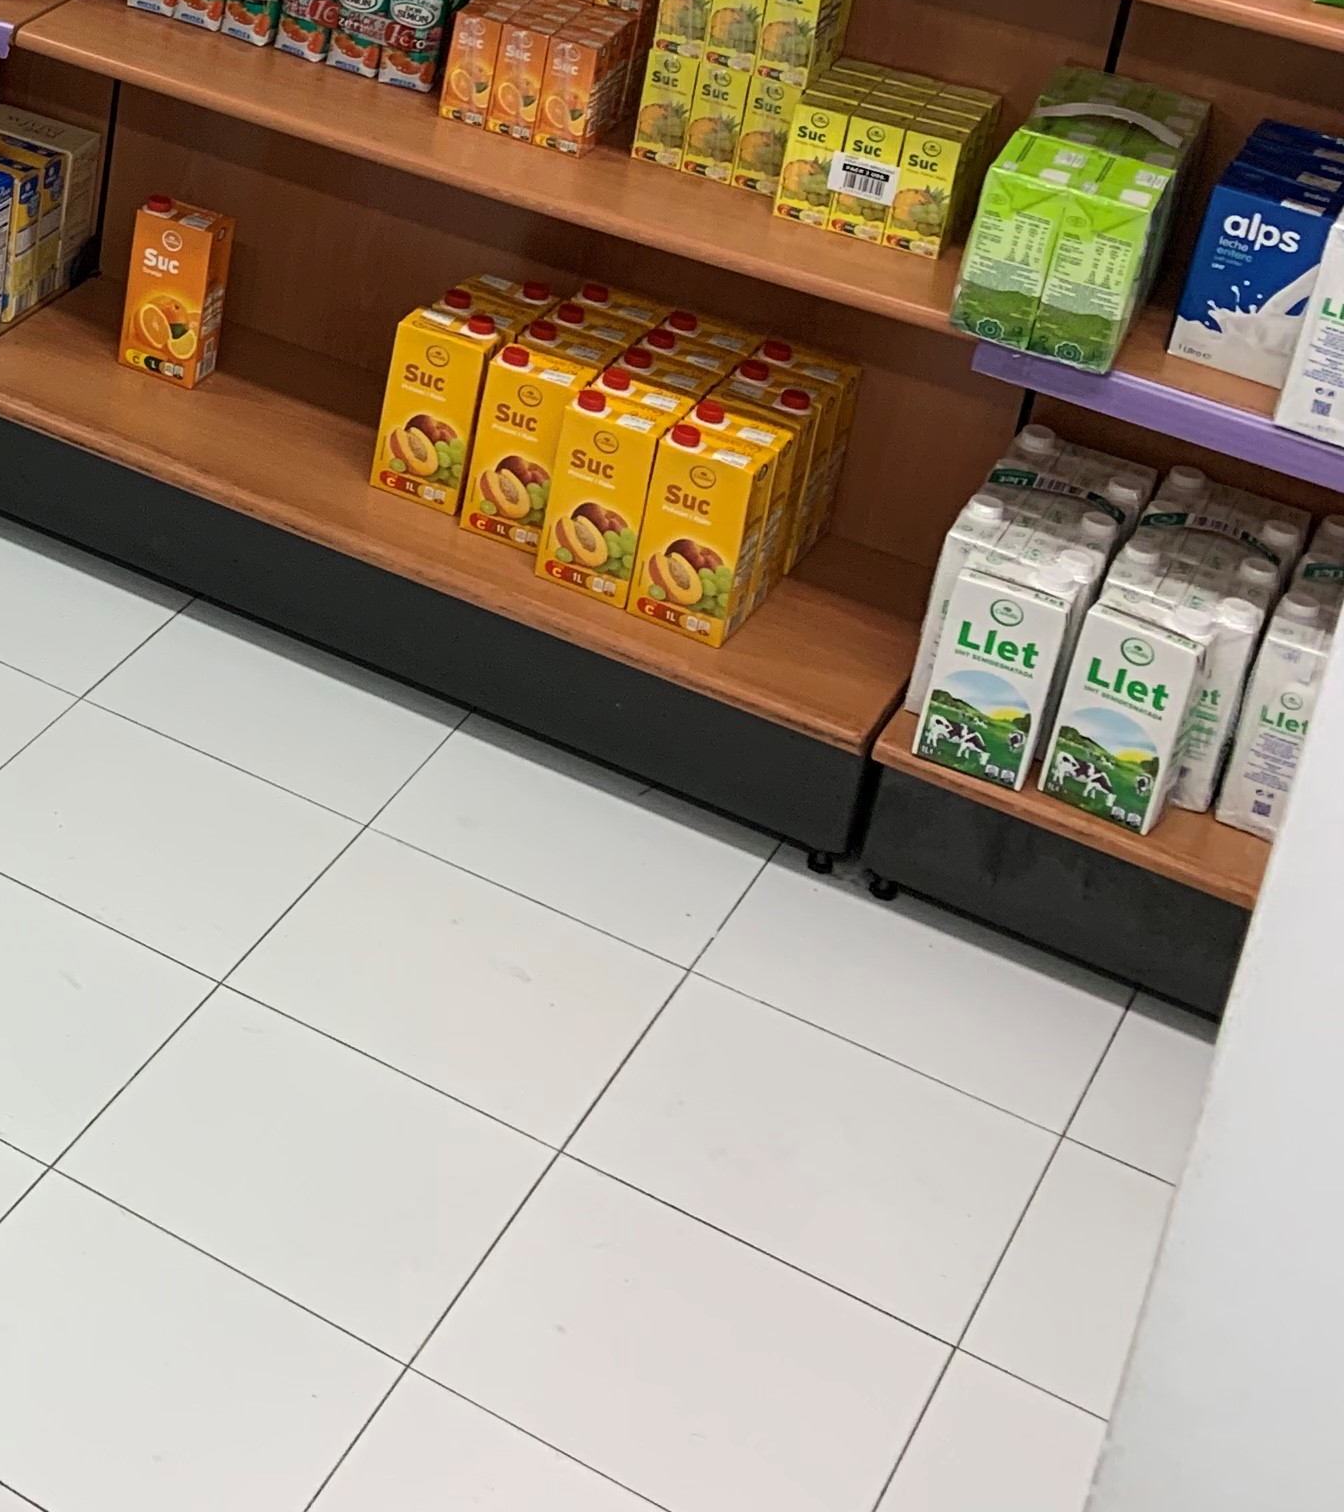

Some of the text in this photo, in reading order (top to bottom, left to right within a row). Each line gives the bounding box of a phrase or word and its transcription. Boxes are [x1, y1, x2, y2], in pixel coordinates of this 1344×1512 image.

[798, 125, 826, 144] Suc
[853, 140, 882, 158] Suc
[908, 154, 938, 172] Suc
[1219, 236, 1249, 252] leche
[1223, 213, 1301, 253] alps
[143, 248, 180, 275] Suc
[404, 363, 446, 392] Suc
[495, 403, 538, 433] Suc
[571, 448, 615, 480] Suc
[665, 484, 711, 516] Suc
[957, 620, 1039, 670] Llet
[1087, 657, 1169, 713] Llet
